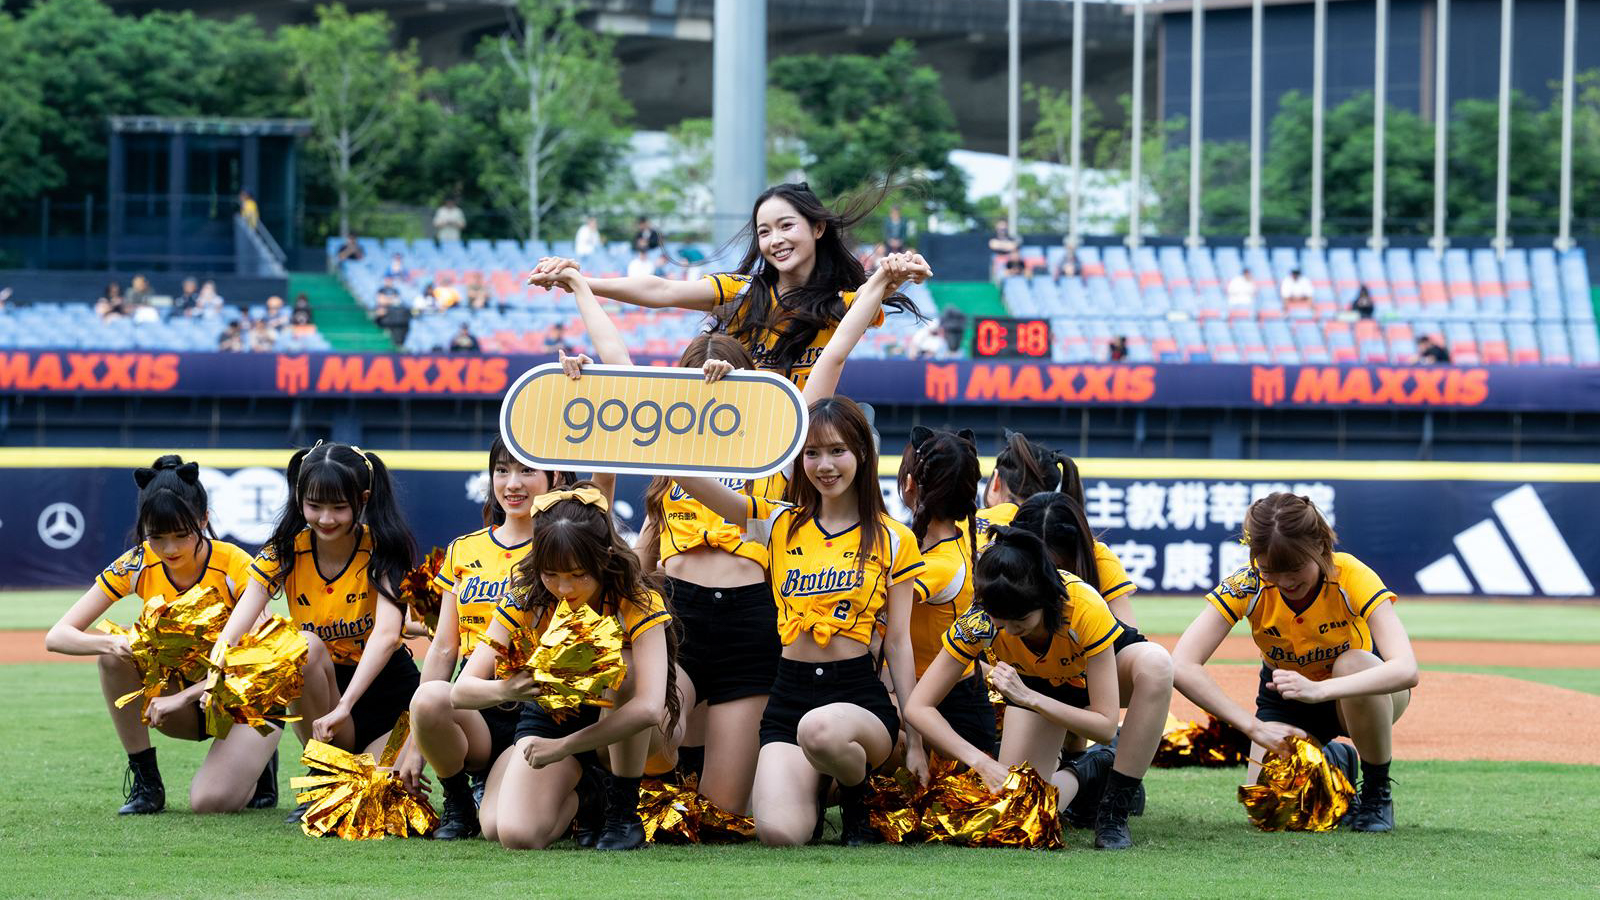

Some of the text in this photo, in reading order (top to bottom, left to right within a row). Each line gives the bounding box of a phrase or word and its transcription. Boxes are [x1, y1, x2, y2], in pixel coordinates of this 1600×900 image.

[0, 353, 180, 390] MAXXIS
[317, 356, 508, 393] MAXXIS
[965, 365, 1156, 402] MAXXIS
[1292, 367, 1489, 405] MAXXIS
[563, 397, 741, 447] gogoro
[459, 575, 509, 605] Brot
[780, 566, 866, 597] Brothers
[302, 612, 374, 641] Brothers
[832, 599, 853, 621] 2
[1266, 640, 1350, 668] Brothers
